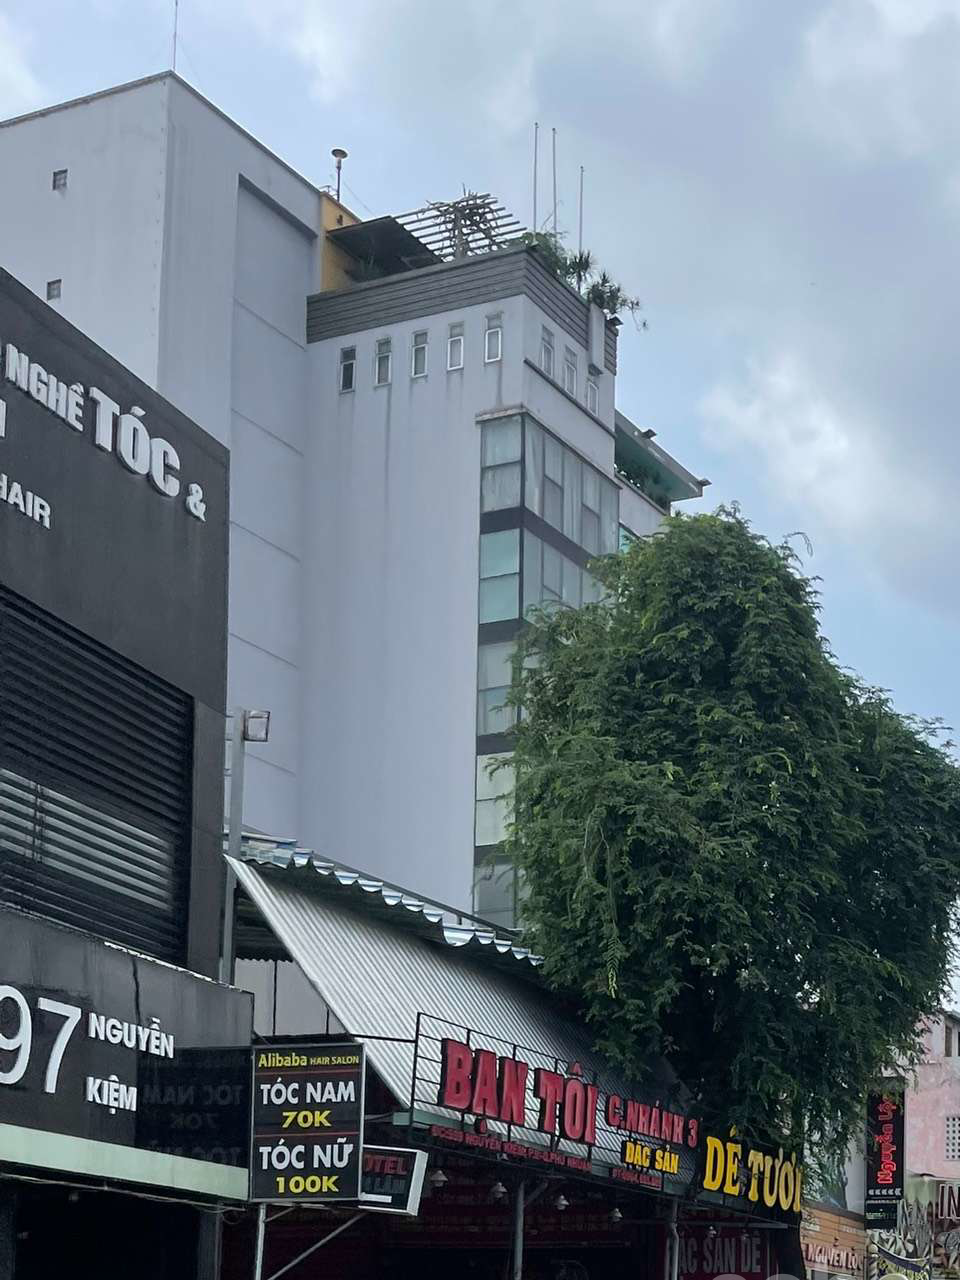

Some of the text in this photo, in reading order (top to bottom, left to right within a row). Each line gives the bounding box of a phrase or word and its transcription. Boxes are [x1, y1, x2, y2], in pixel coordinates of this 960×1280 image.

[90, 386, 180, 497] TÓC
[186, 483, 206, 522] &
[87, 1012, 175, 1059] NGUYỄN
[258, 1052, 360, 1069] Alibaba HAIR SALON
[86, 1074, 137, 1115] KIỆM
[260, 1076, 356, 1105] TÓC NAM
[441, 1038, 528, 1134] BẠN
[534, 1061, 598, 1146] TÔI
[281, 1109, 332, 1129] 70K
[258, 1136, 355, 1171] TÓC NỮ
[275, 1174, 340, 1195] 100K
